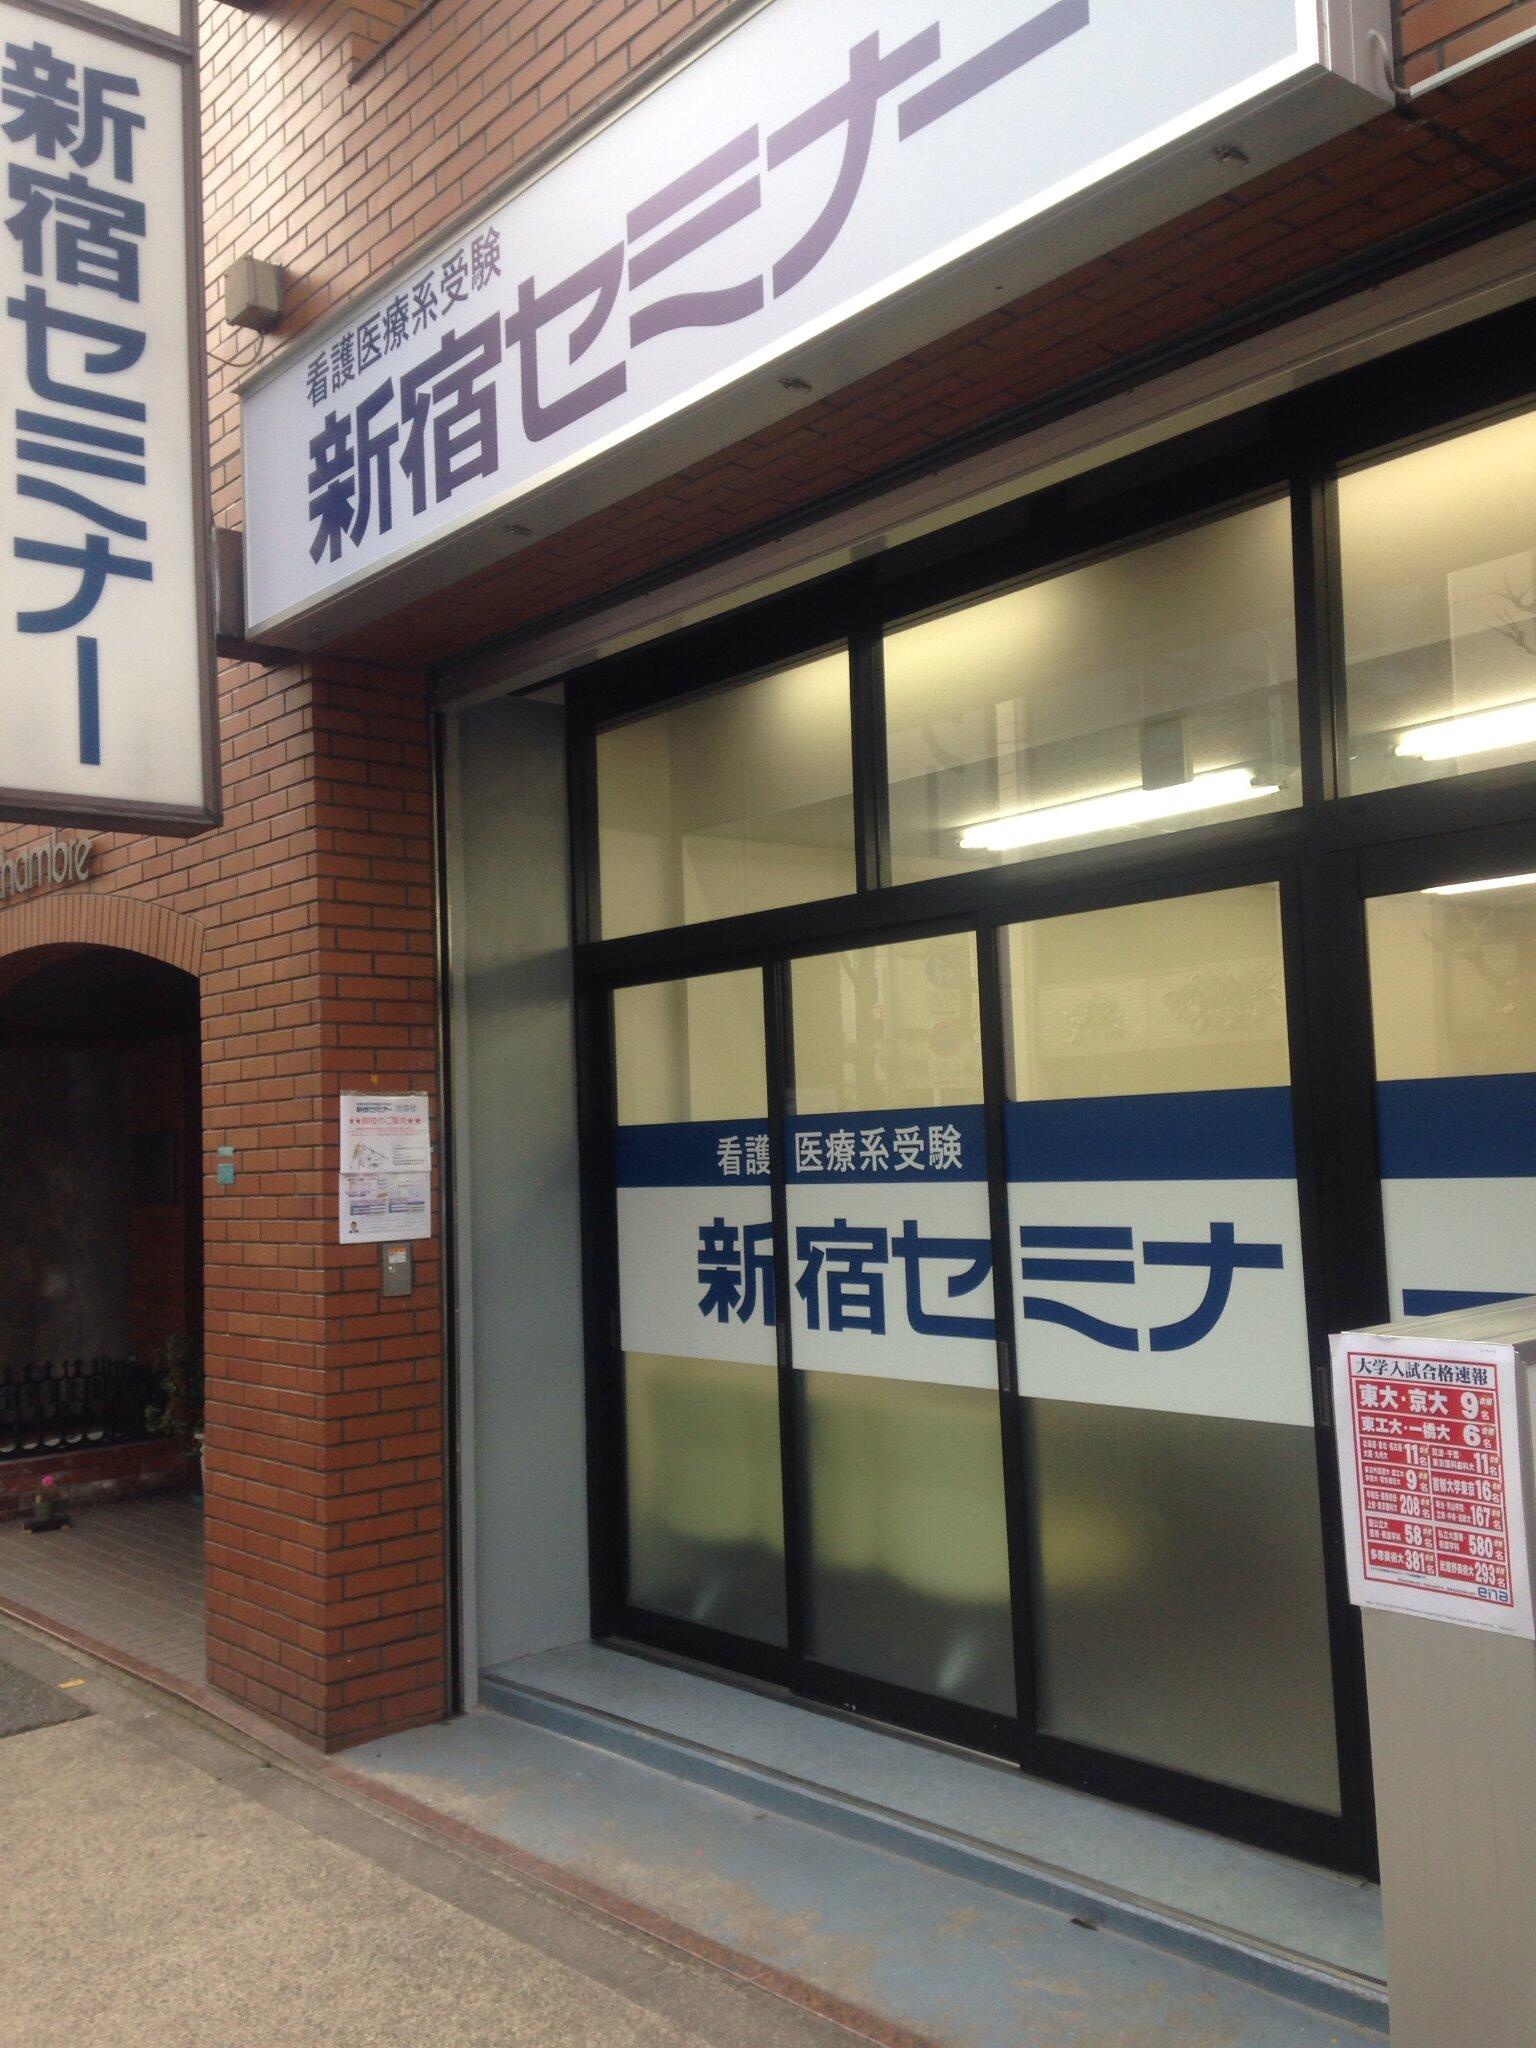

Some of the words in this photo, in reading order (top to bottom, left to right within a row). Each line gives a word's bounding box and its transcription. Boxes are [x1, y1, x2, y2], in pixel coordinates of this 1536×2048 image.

[307, 0, 1090, 564] 新宿セミナー
[305, 225, 502, 408] 看護医療系受験
[1, 41, 153, 766] 新宿セミナー
[1356, 1356, 1488, 1386] 大学入試合格速報
[1359, 1382, 1449, 1416] 東大・京大
[1461, 1391, 1479, 1420] 9
[1361, 1415, 1451, 1442] 東工大・一橋大
[1463, 1425, 1482, 1448] 6
[1404, 1443, 1419, 1465] 11
[1474, 1452, 1490, 1475] 11
[1405, 1469, 1418, 1491] 9
[1475, 1480, 1492, 1502] 16
[1400, 1494, 1421, 1517] 208
[1471, 1505, 1491, 1528] 167
[1404, 1523, 1423, 1546] 58
[1468, 1535, 1494, 1559] 580
[1404, 1549, 1426, 1573] 381
[1474, 1561, 1496, 1586] 293
[1477, 1586, 1509, 1602] ena
